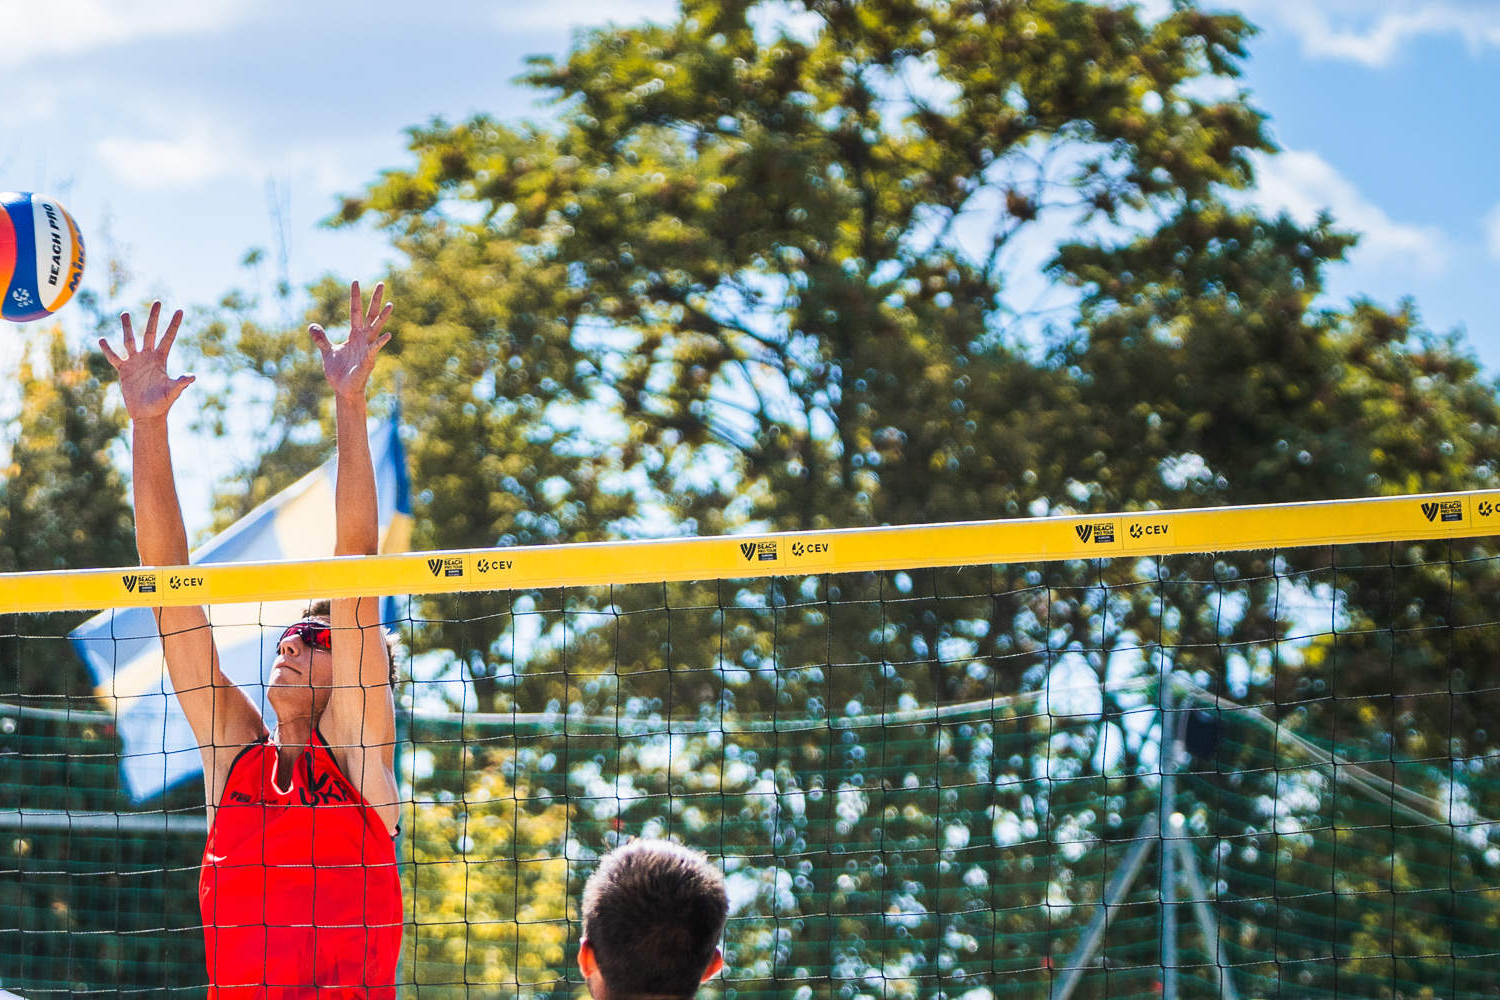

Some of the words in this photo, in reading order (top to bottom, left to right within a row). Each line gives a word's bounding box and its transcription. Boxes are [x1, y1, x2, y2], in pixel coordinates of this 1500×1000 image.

[42, 203, 59, 230] PRO
[48, 232, 61, 286] BEACH
[1145, 525, 1168, 534] CEV
[807, 543, 829, 553] CEV
[491, 561, 512, 569] CEV
[183, 578, 204, 587] CEV
